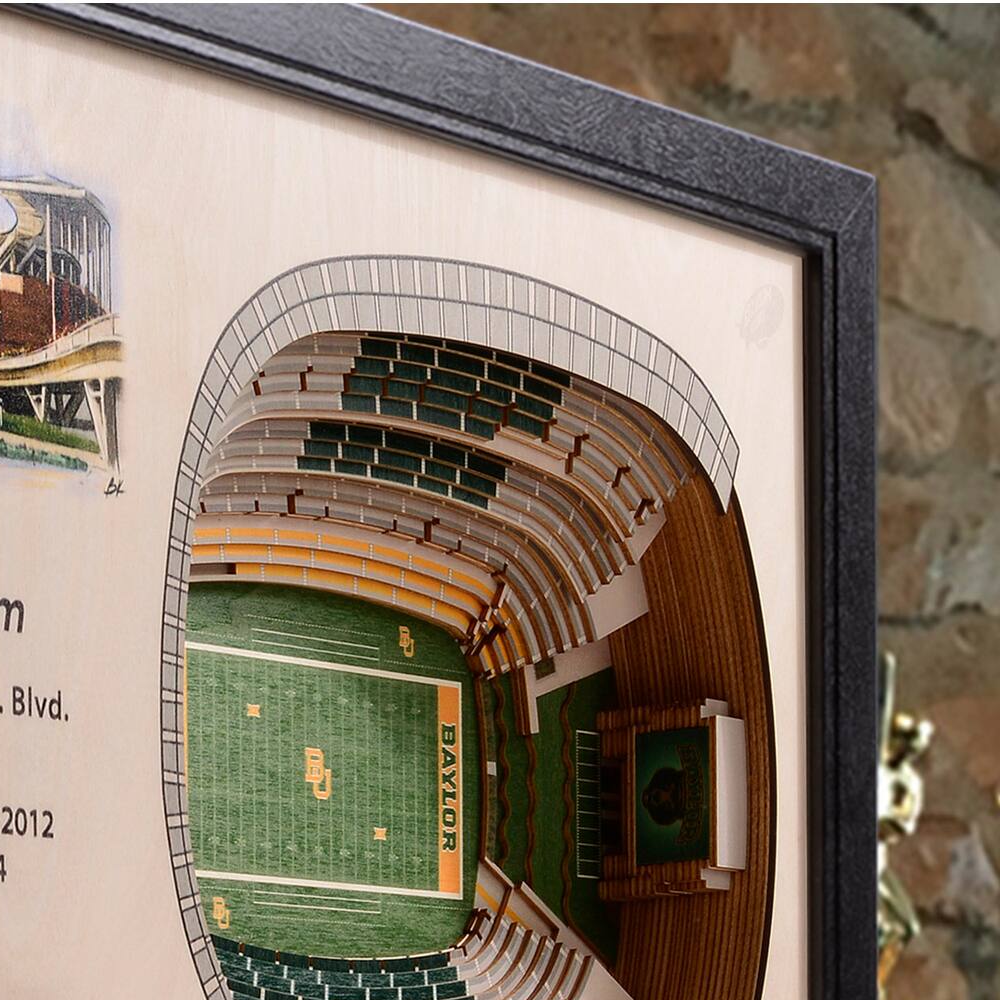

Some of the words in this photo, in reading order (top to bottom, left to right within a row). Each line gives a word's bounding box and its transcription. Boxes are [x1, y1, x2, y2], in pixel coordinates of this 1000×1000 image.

[12, 685, 69, 722] Blvd.
[441, 722, 458, 853] BAYLOR
[0, 805, 54, 839] 2012
